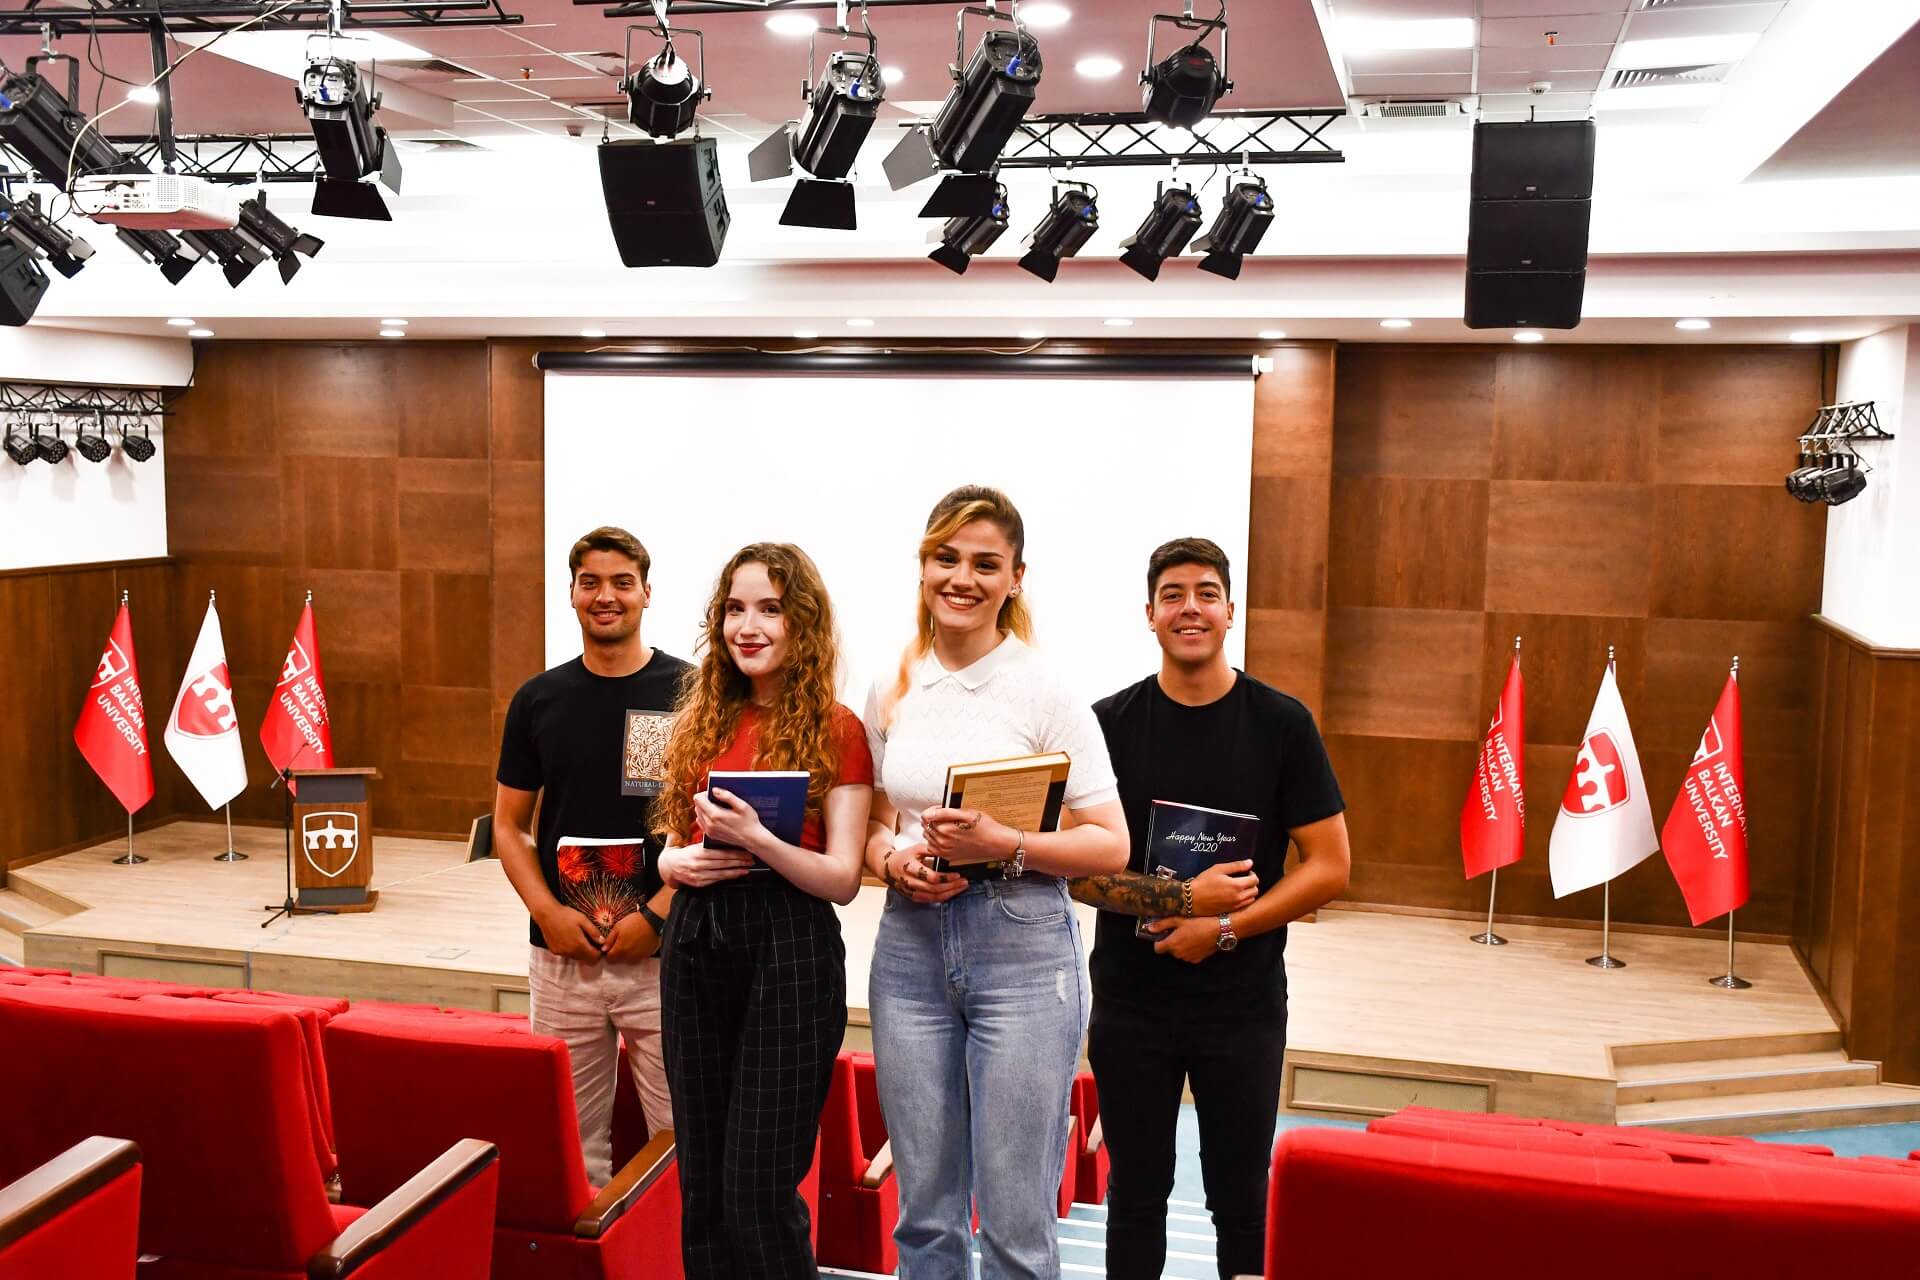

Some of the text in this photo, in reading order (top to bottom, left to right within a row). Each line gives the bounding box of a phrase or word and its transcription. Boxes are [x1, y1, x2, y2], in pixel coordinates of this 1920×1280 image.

[97, 694, 147, 756] UNIVERSITY
[110, 684, 144, 729] BALKAN
[280, 692, 325, 754] UNIVERSITY
[1479, 748, 1498, 820] NIVERSITY
[1485, 739, 1504, 792] BALKAN
[1685, 777, 1729, 859] UNIVERSITY
[1698, 769, 1733, 828] BALKAN
[1166, 831, 1236, 844] Happy New Year
[1190, 842, 1218, 852] 2020
